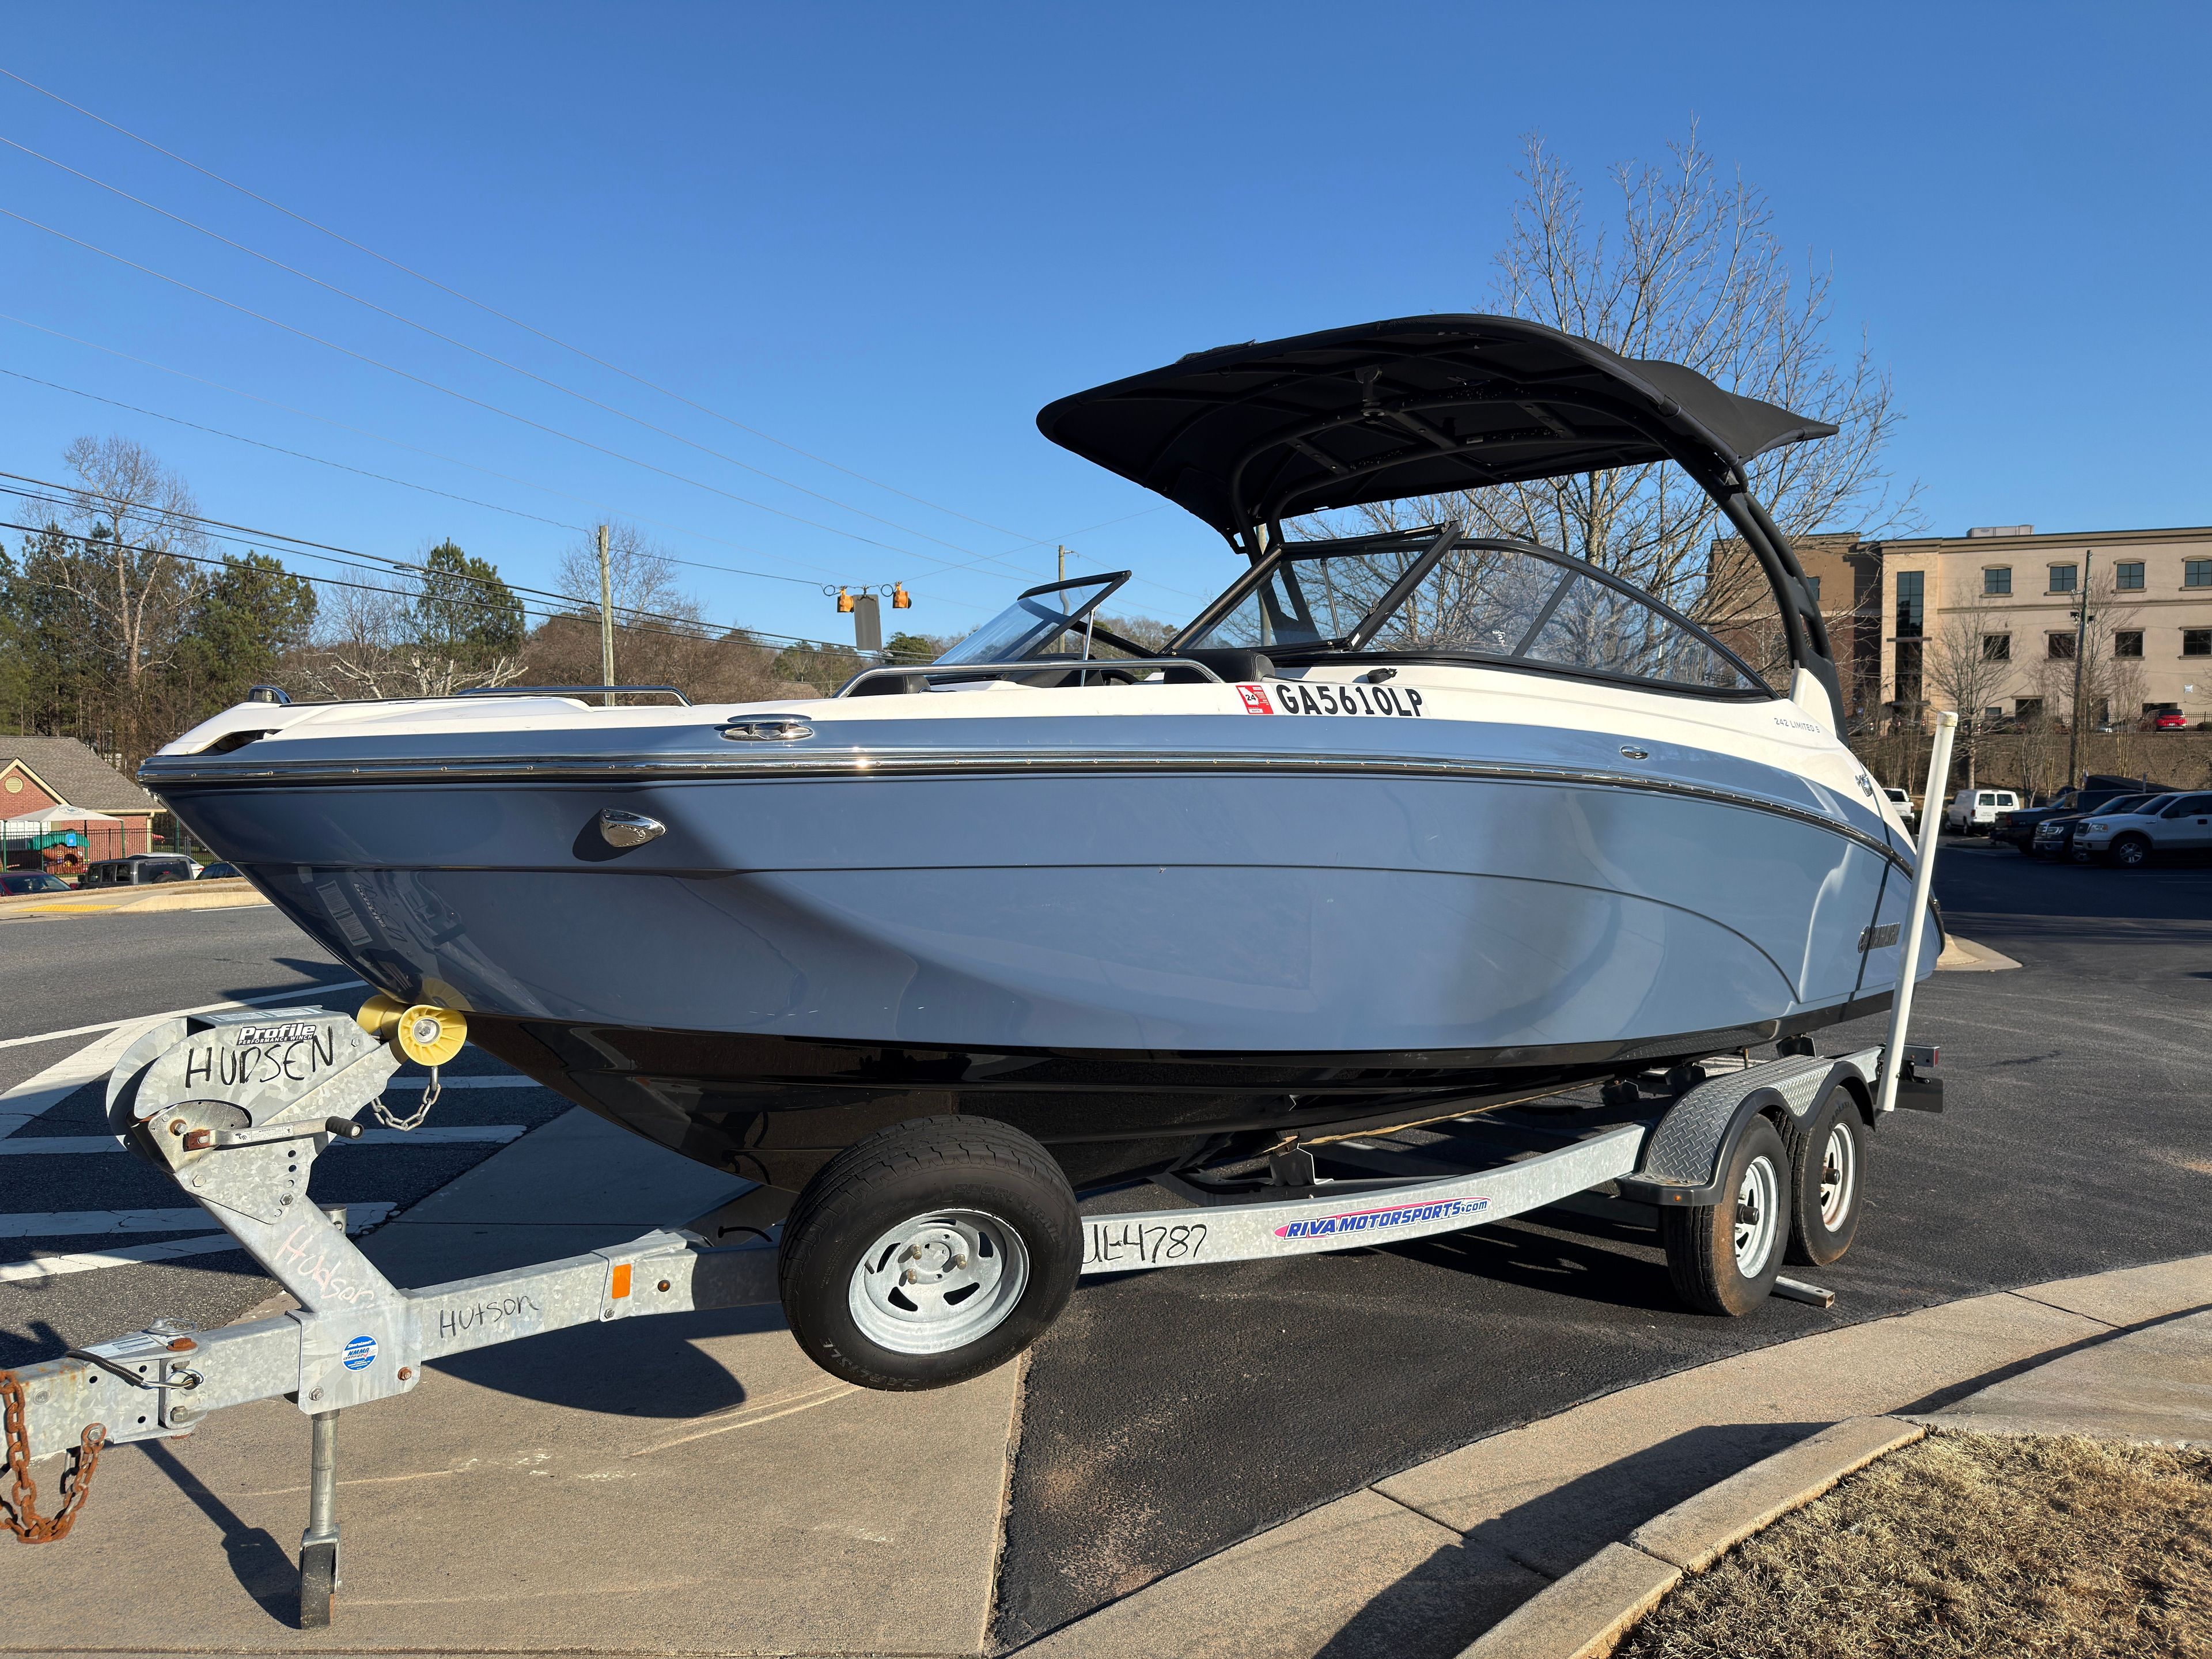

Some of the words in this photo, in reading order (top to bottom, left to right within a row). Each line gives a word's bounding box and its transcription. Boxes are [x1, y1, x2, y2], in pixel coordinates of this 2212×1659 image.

[1276, 684, 1423, 717] GA5610LP
[1774, 718, 1789, 726] 242
[1790, 720, 1815, 732] LIMITED
[239, 1023, 316, 1040] Profile
[238, 1036, 288, 1045] PERFORMANCE
[185, 1025, 334, 1088] HUDSEN
[347, 1347, 370, 1357] NMMA
